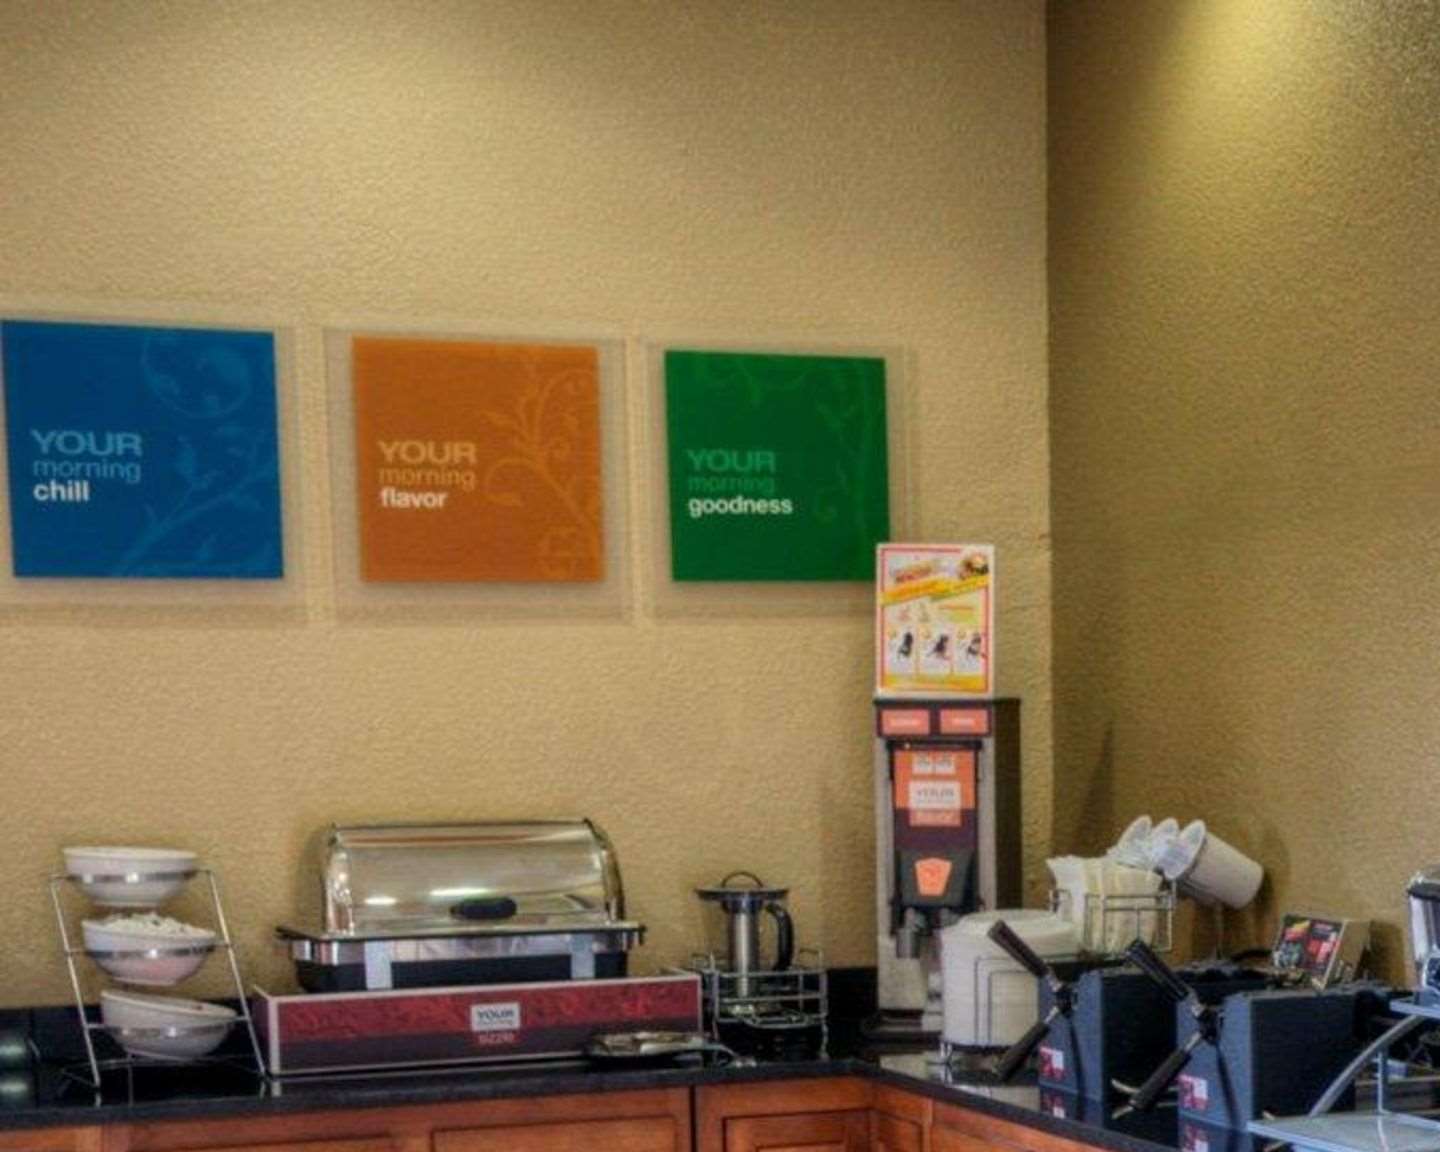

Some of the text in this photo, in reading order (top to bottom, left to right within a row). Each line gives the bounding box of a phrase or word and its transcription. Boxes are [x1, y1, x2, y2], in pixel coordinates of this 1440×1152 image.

[30, 428, 143, 456] YOUR
[377, 439, 478, 464] YOUR
[32, 459, 142, 484] morning
[685, 449, 777, 473] YOUR
[33, 478, 91, 502] chill
[378, 465, 477, 491] morning
[688, 475, 776, 497] morning
[381, 486, 449, 508] flavor
[688, 494, 794, 519] goodness
